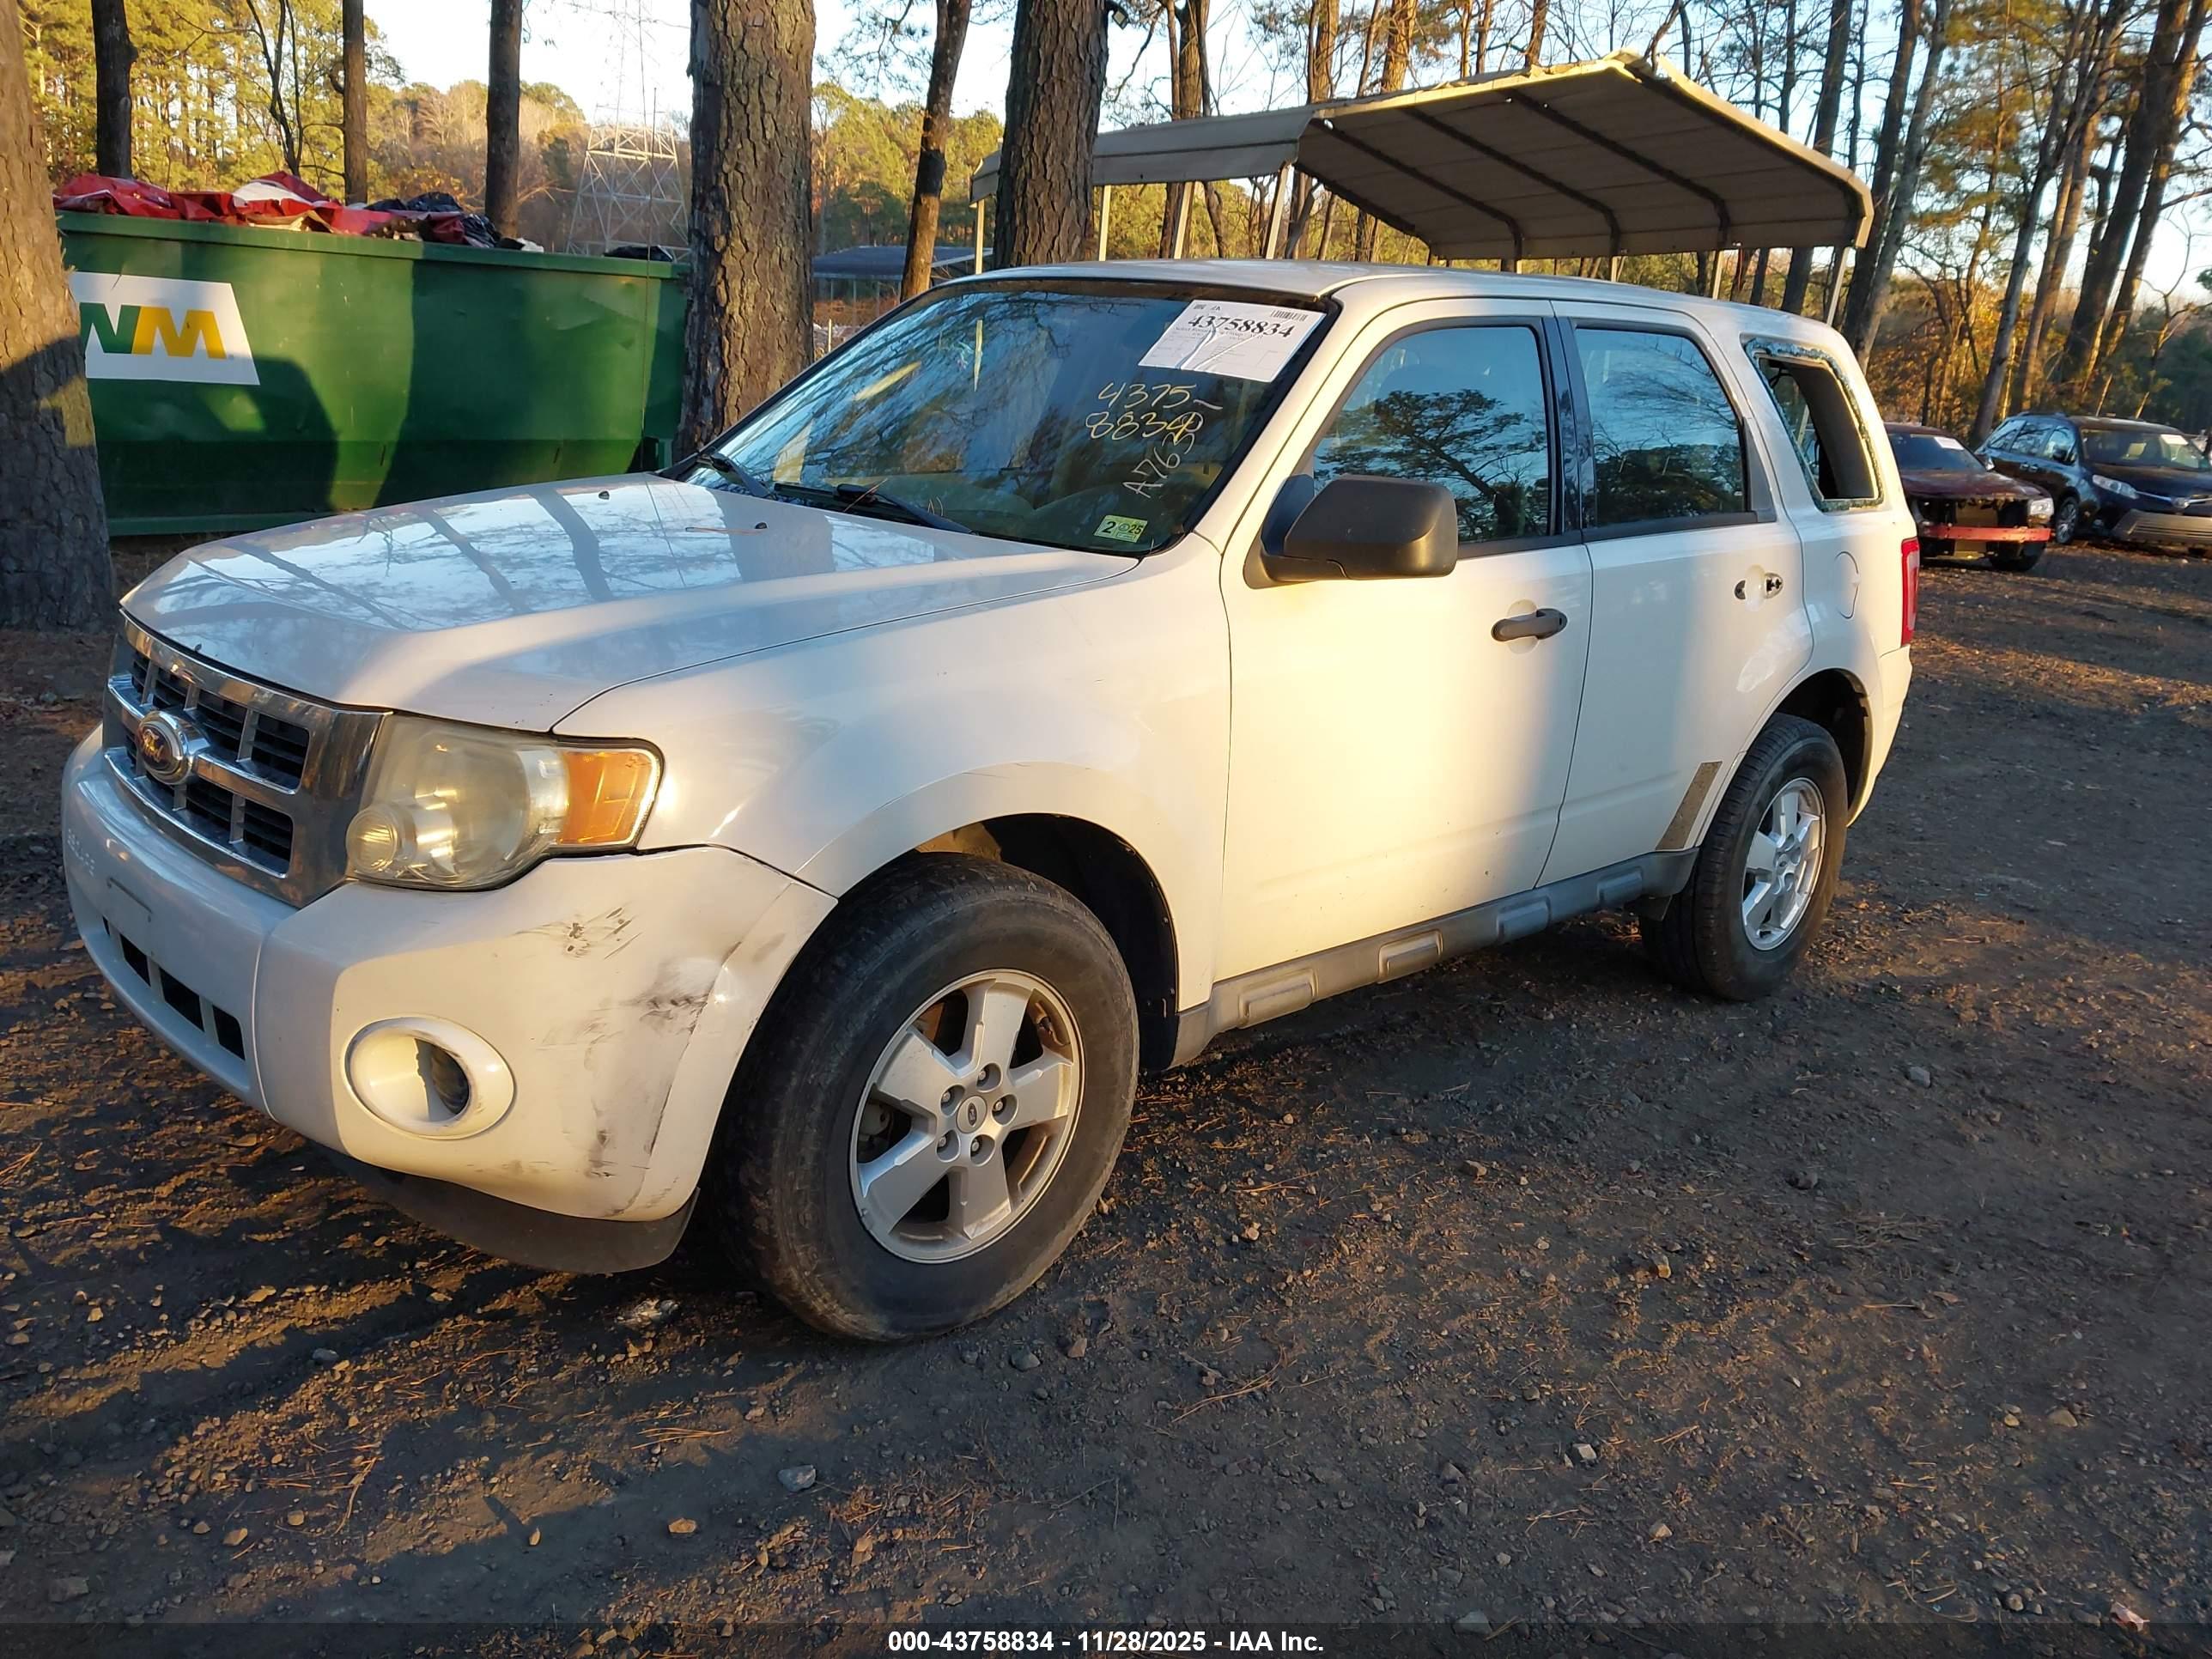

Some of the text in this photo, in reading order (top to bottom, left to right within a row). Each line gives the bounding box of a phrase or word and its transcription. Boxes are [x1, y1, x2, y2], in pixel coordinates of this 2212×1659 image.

[1188, 314, 1296, 338] 43758834
[1097, 382, 1197, 409] 4375
[1102, 521, 1143, 535] 2 25
